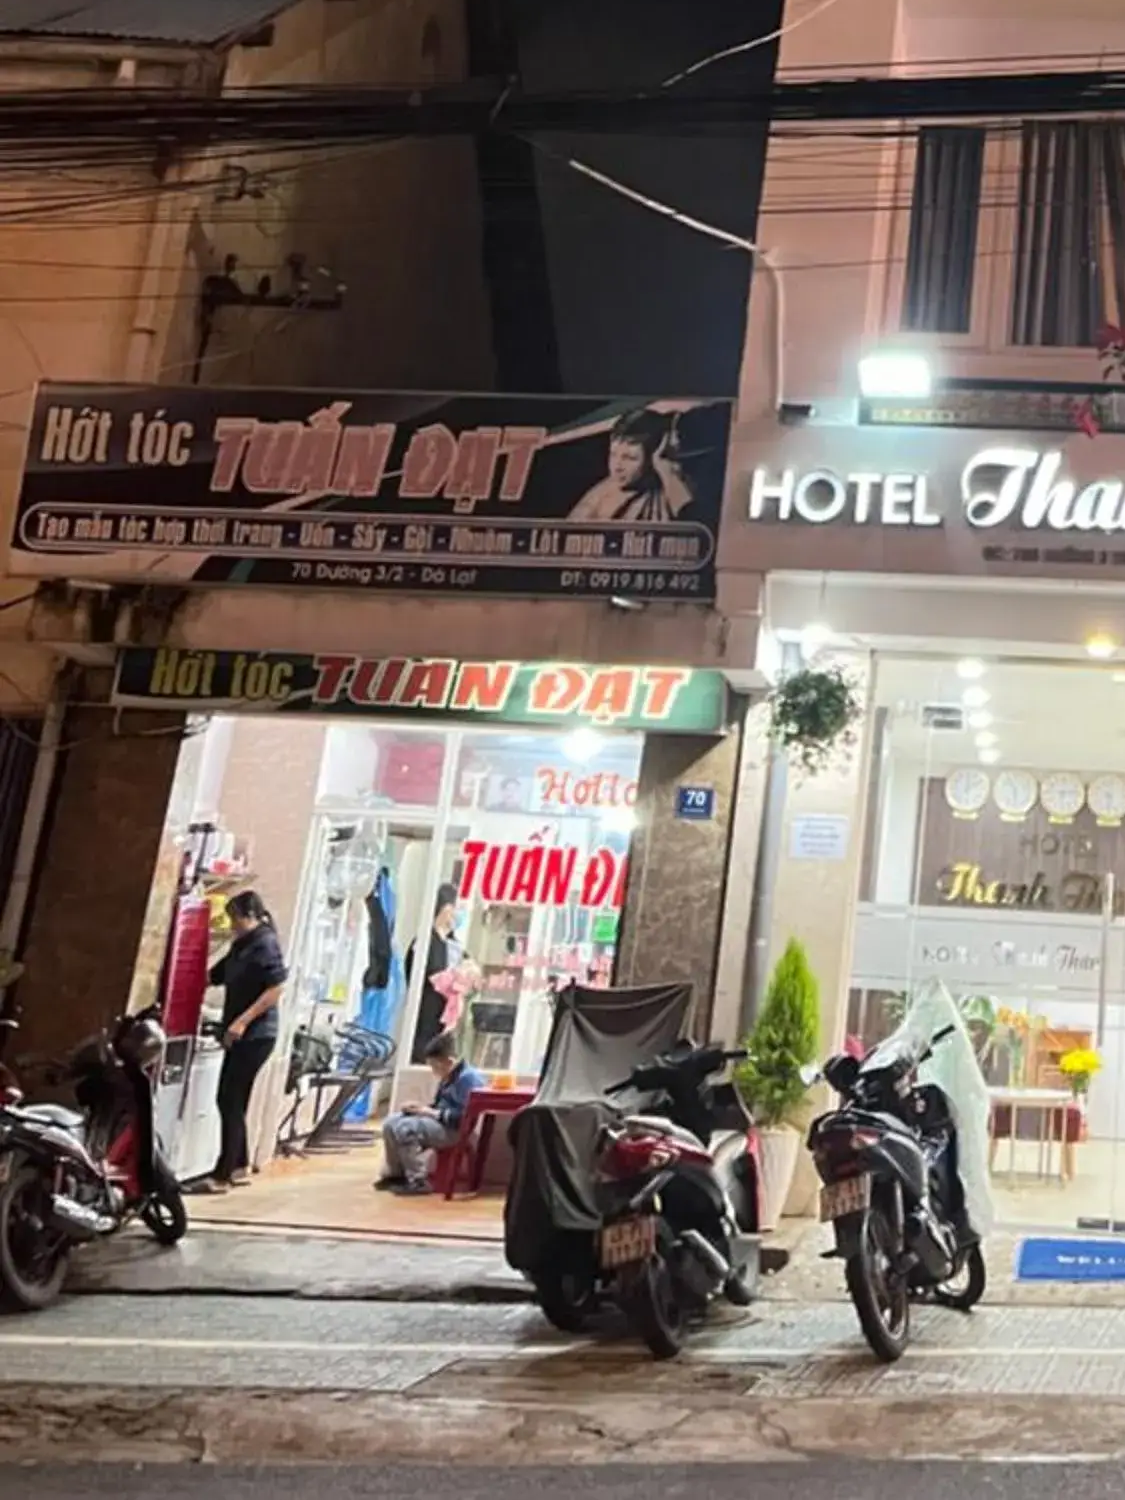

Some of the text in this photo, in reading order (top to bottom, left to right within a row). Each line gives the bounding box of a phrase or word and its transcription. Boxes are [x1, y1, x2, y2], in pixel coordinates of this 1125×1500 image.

[40, 401, 547, 514] Hớt tóc TUẤN ĐẠT
[748, 468, 941, 528] HOTEL
[375, 565, 404, 582] 3/2
[230, 650, 294, 701] tóc
[526, 663, 692, 724] ĐẠT
[687, 790, 706, 807] 70
[459, 825, 577, 905] TUẤN
